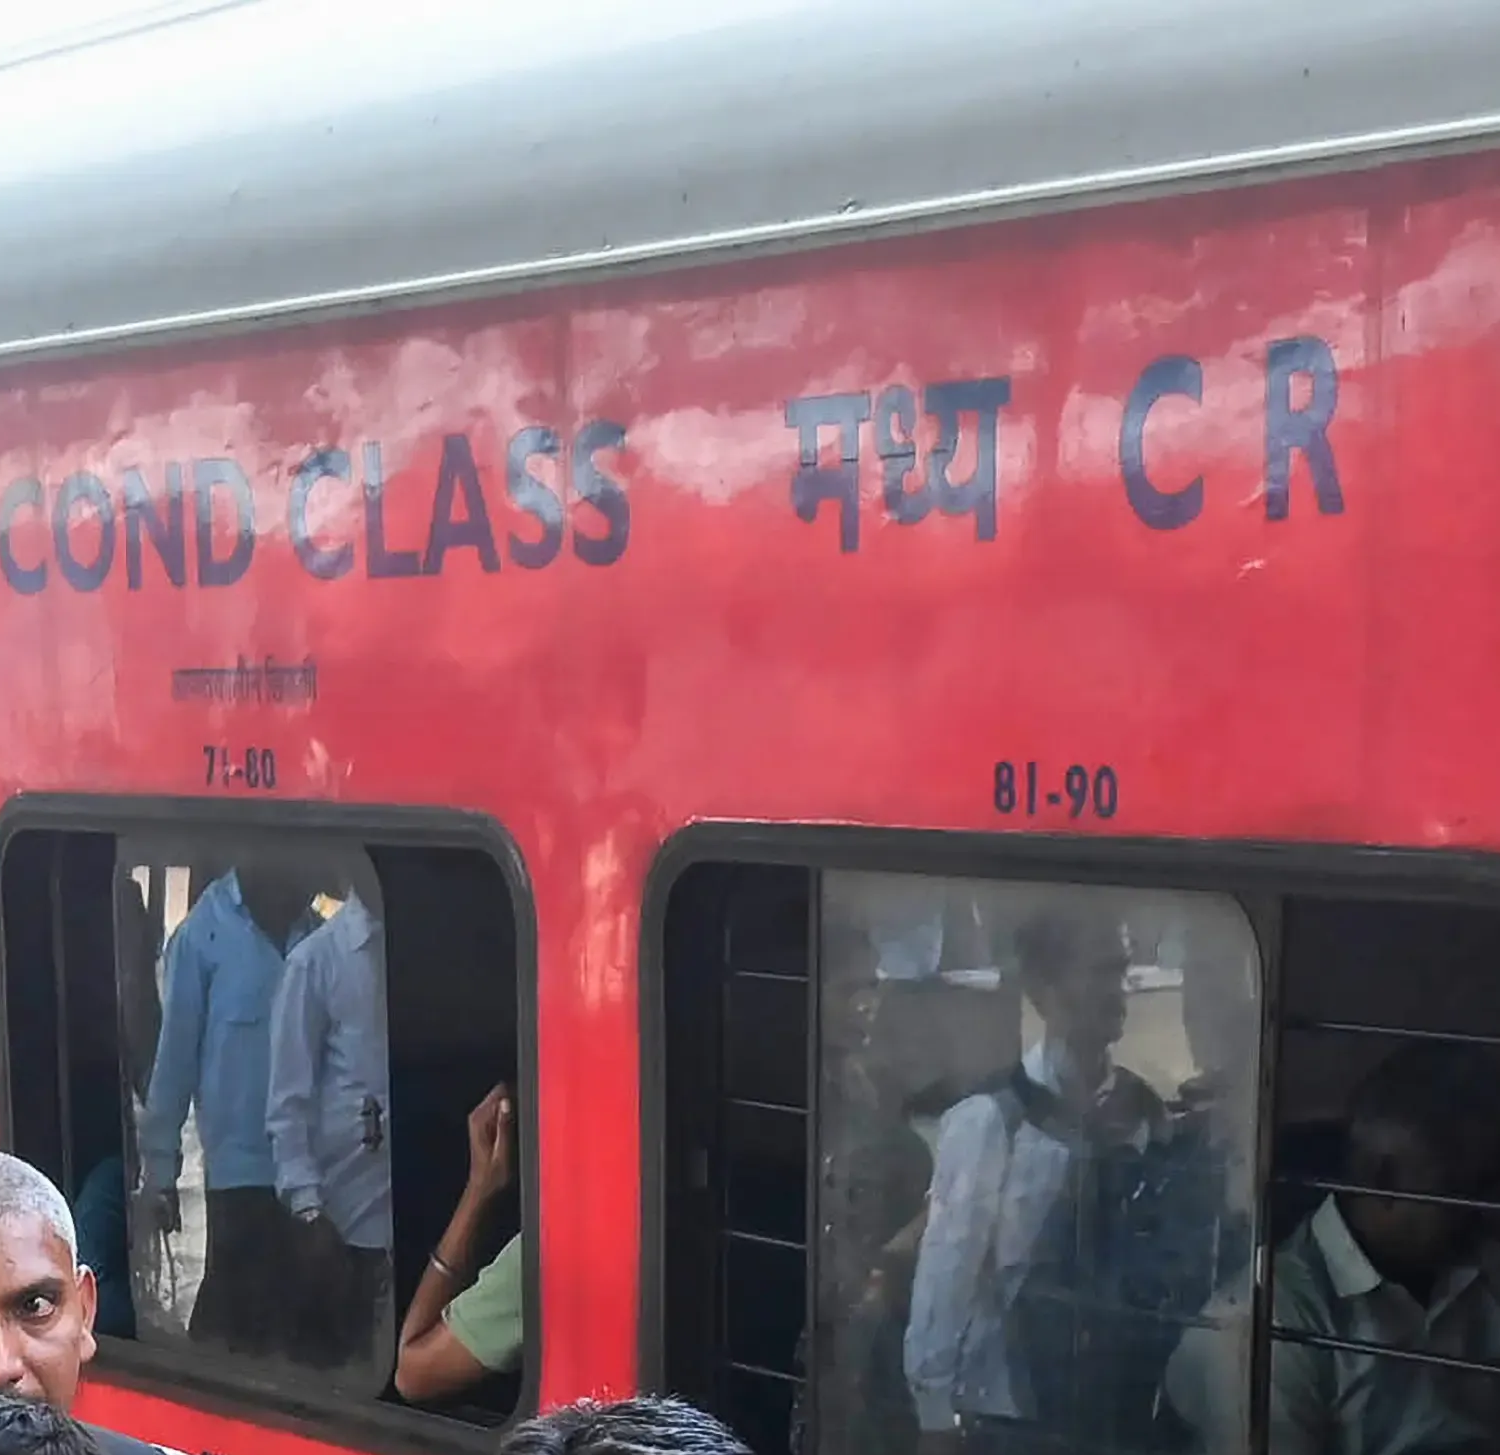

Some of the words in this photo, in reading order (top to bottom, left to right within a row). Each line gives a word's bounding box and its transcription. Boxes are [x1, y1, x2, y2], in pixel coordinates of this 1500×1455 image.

[290, 420, 630, 580] CLASS
[784, 375, 1011, 553] मध्य
[1118, 354, 1204, 531] C
[1262, 335, 1345, 521] R
[203, 745, 276, 789] 71-80
[993, 761, 1118, 819] 81-90
